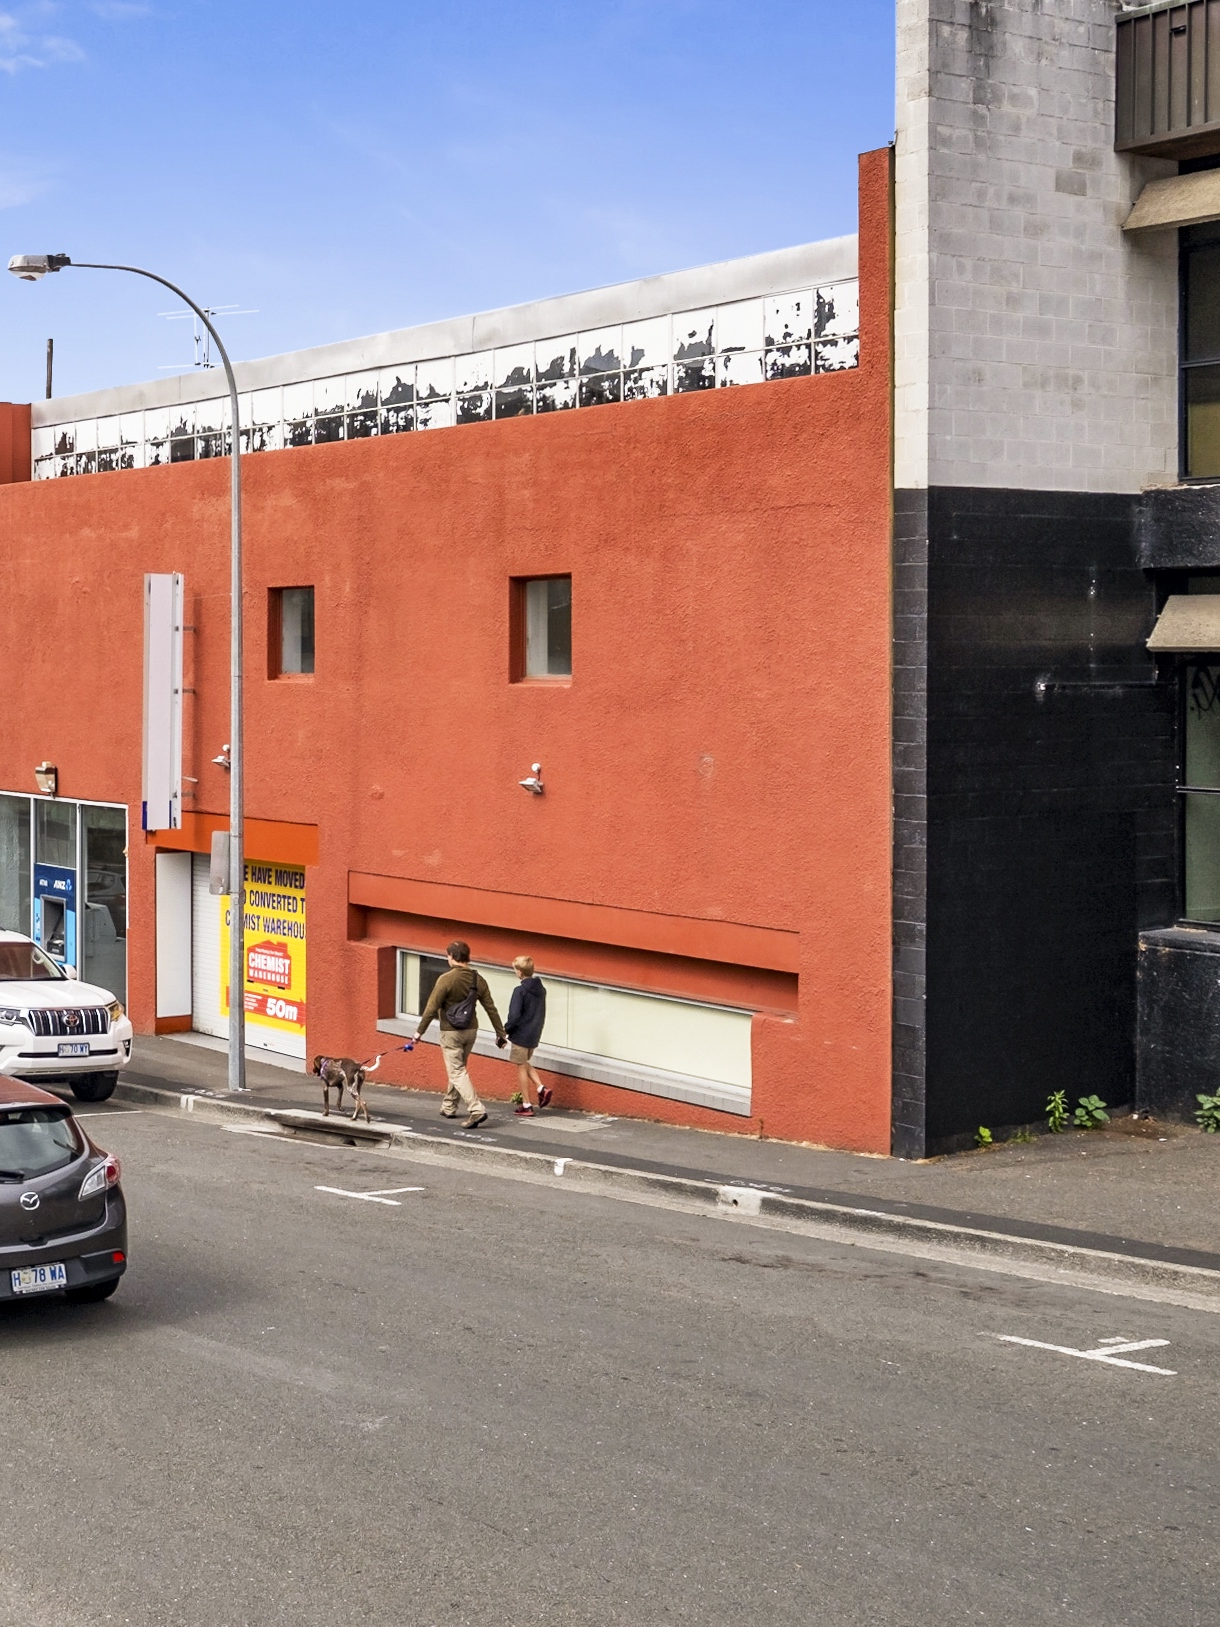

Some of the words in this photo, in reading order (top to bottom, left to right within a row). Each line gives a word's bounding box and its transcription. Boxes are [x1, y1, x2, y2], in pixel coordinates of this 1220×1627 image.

[53, 880, 66, 890] ANZ
[251, 865, 272, 885] HAVE
[275, 868, 304, 890] MOVED
[250, 889, 298, 913] CONVERTED
[249, 952, 291, 975] CHEMIST
[249, 968, 289, 985] WAREHOUSE
[266, 997, 298, 1021] 50m
[13, 1272, 21, 1287] H
[31, 1268, 46, 1283] 78
[49, 1265, 65, 1281] WA
